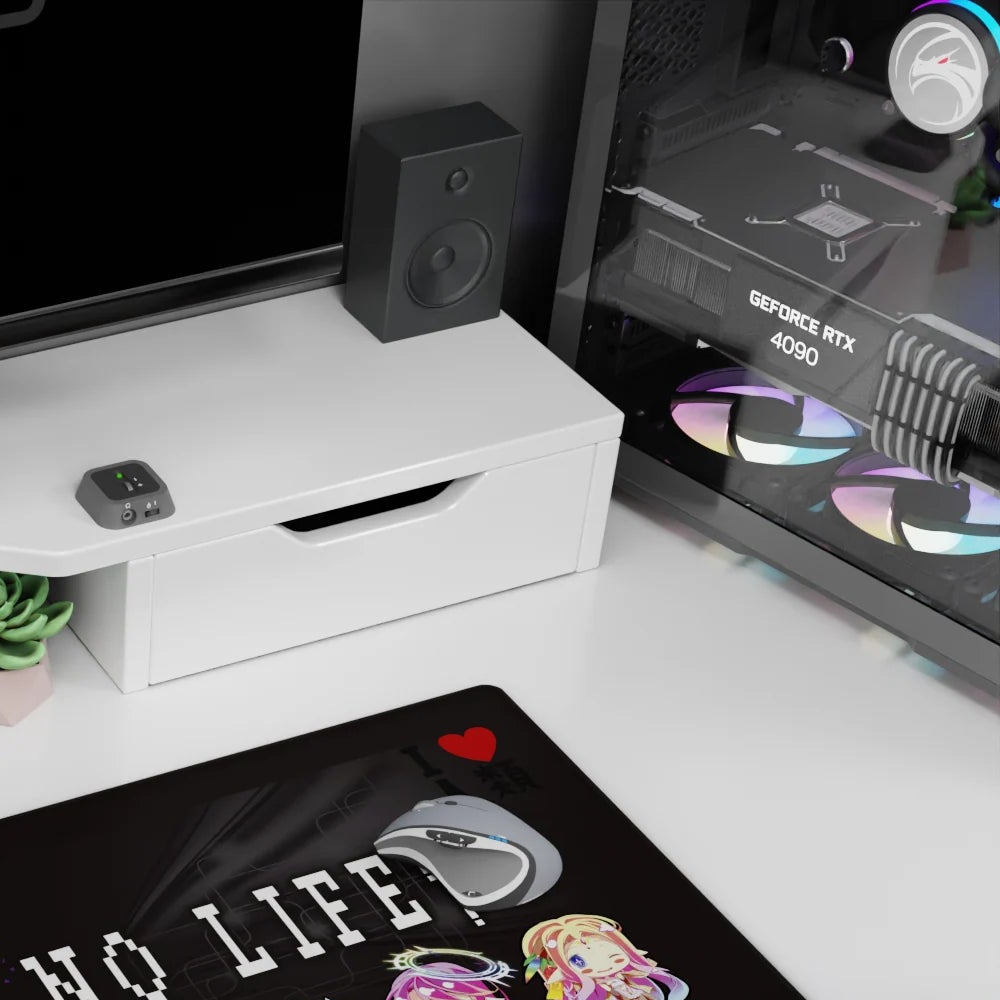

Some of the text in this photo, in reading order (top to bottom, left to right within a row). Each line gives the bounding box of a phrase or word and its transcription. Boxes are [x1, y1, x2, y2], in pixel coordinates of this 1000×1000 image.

[749, 289, 857, 354] GEFORCE RTX
[769, 331, 819, 367] 4090
